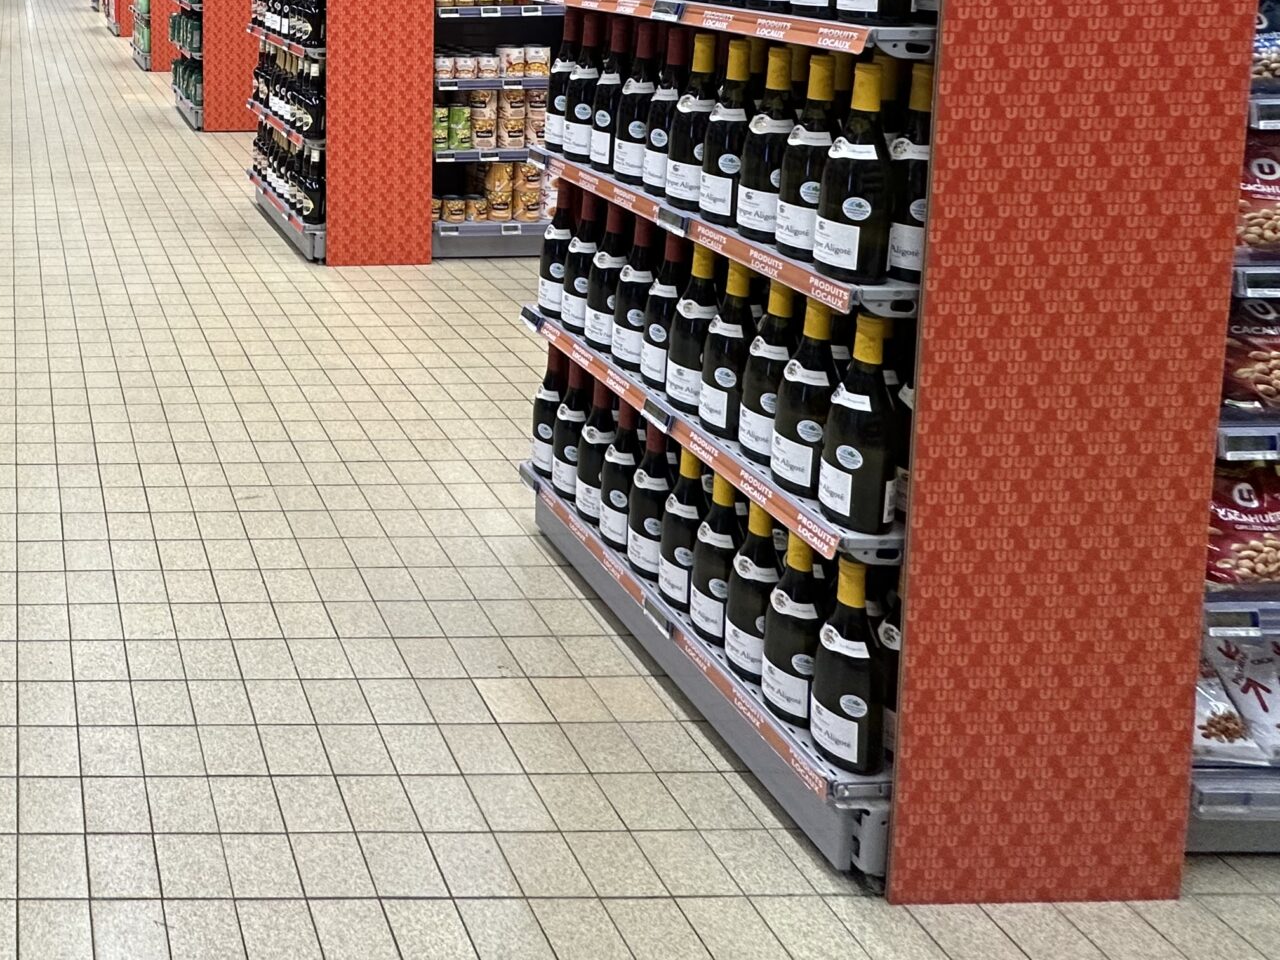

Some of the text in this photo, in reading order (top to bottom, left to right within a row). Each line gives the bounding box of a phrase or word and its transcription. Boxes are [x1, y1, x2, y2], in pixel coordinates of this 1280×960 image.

[756, 27, 785, 39] LOCAUX
[757, 18, 792, 31] PRODUITS
[818, 27, 859, 41] PRODUITS
[817, 37, 852, 50] LOCAUX
[697, 225, 728, 245] PRODUITS
[699, 235, 724, 251] LOCAUX
[823, 240, 853, 257] Aligoté
[749, 249, 783, 270] PRODUITS
[751, 259, 779, 278] LOCAUX
[809, 276, 849, 301] PRODUITS
[811, 287, 845, 308] LOCAUX
[689, 431, 720, 459] PRODUITS
[689, 441, 715, 465] LOCAUX
[739, 469, 774, 500] PRODUITS
[739, 480, 768, 505] LOCAUX
[796, 512, 837, 548] PRODUITS
[797, 524, 830, 554] LOCAUX
